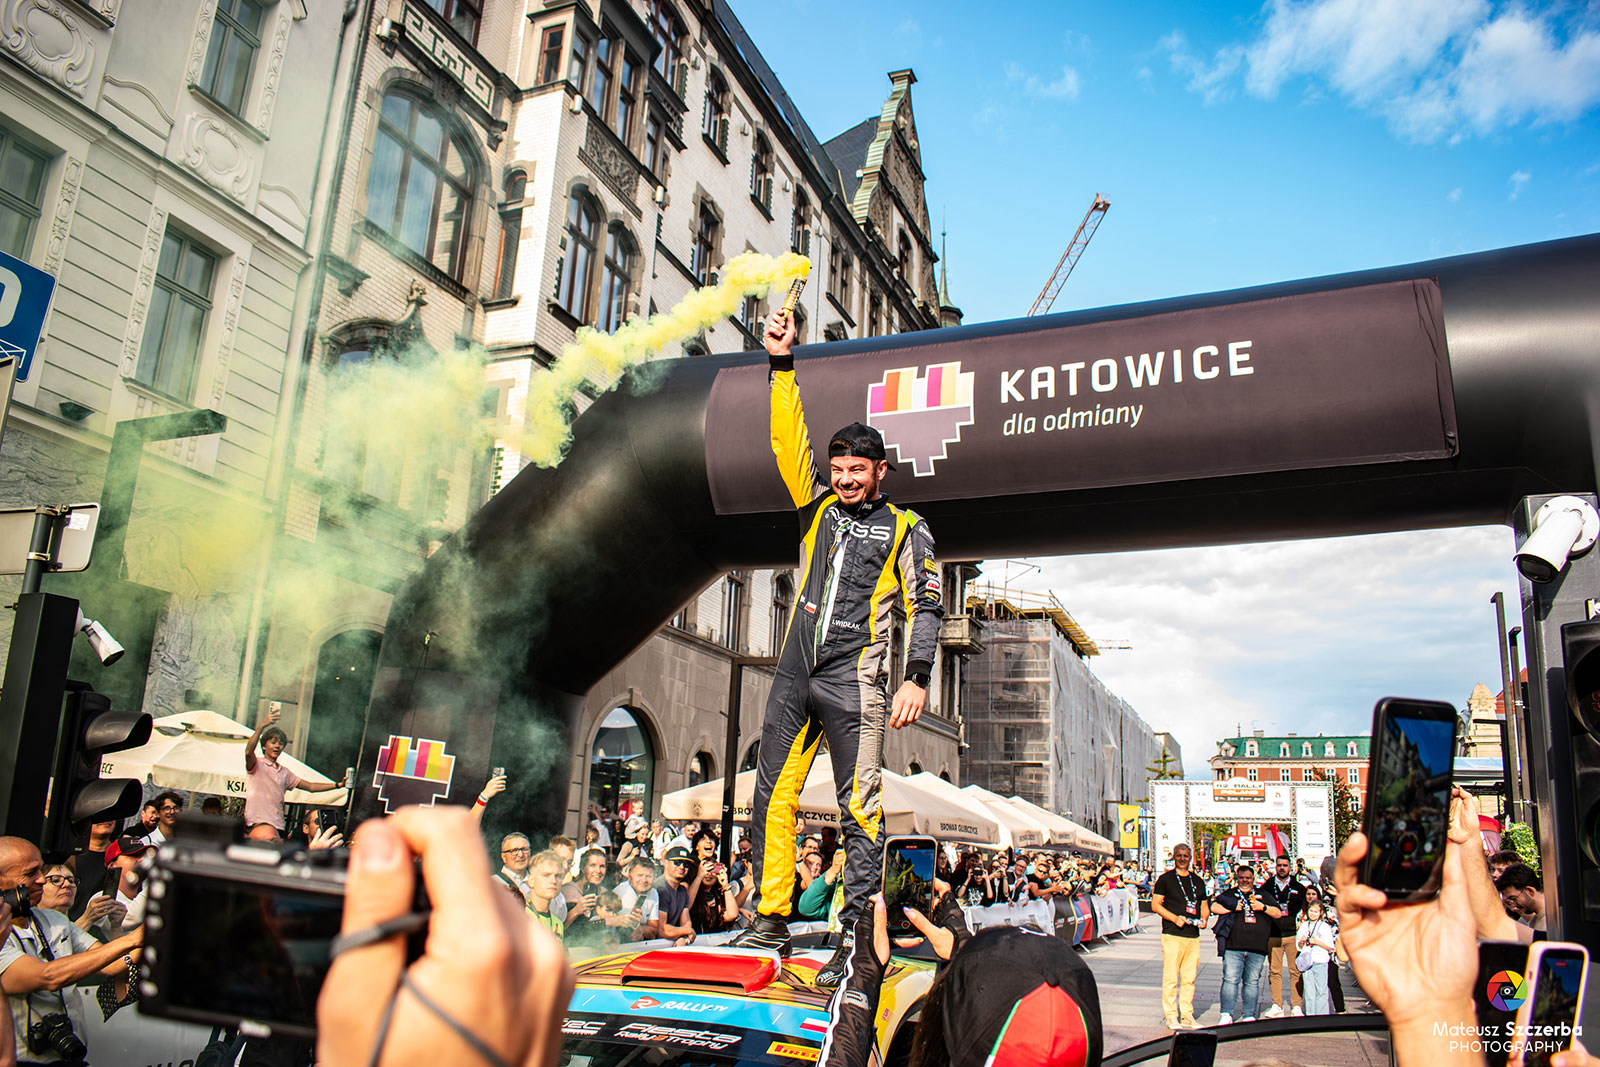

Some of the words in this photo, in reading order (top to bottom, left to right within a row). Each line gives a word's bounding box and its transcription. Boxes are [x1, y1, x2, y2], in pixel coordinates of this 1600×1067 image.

[1000, 340, 1255, 404] KATOWICE
[1003, 412, 1037, 436] dla
[1042, 404, 1144, 433] odmiany
[100, 763, 114, 775] ĘCE
[227, 780, 247, 793] KSI
[733, 807, 754, 816] BRO
[618, 1022, 742, 1044] Fiesta
